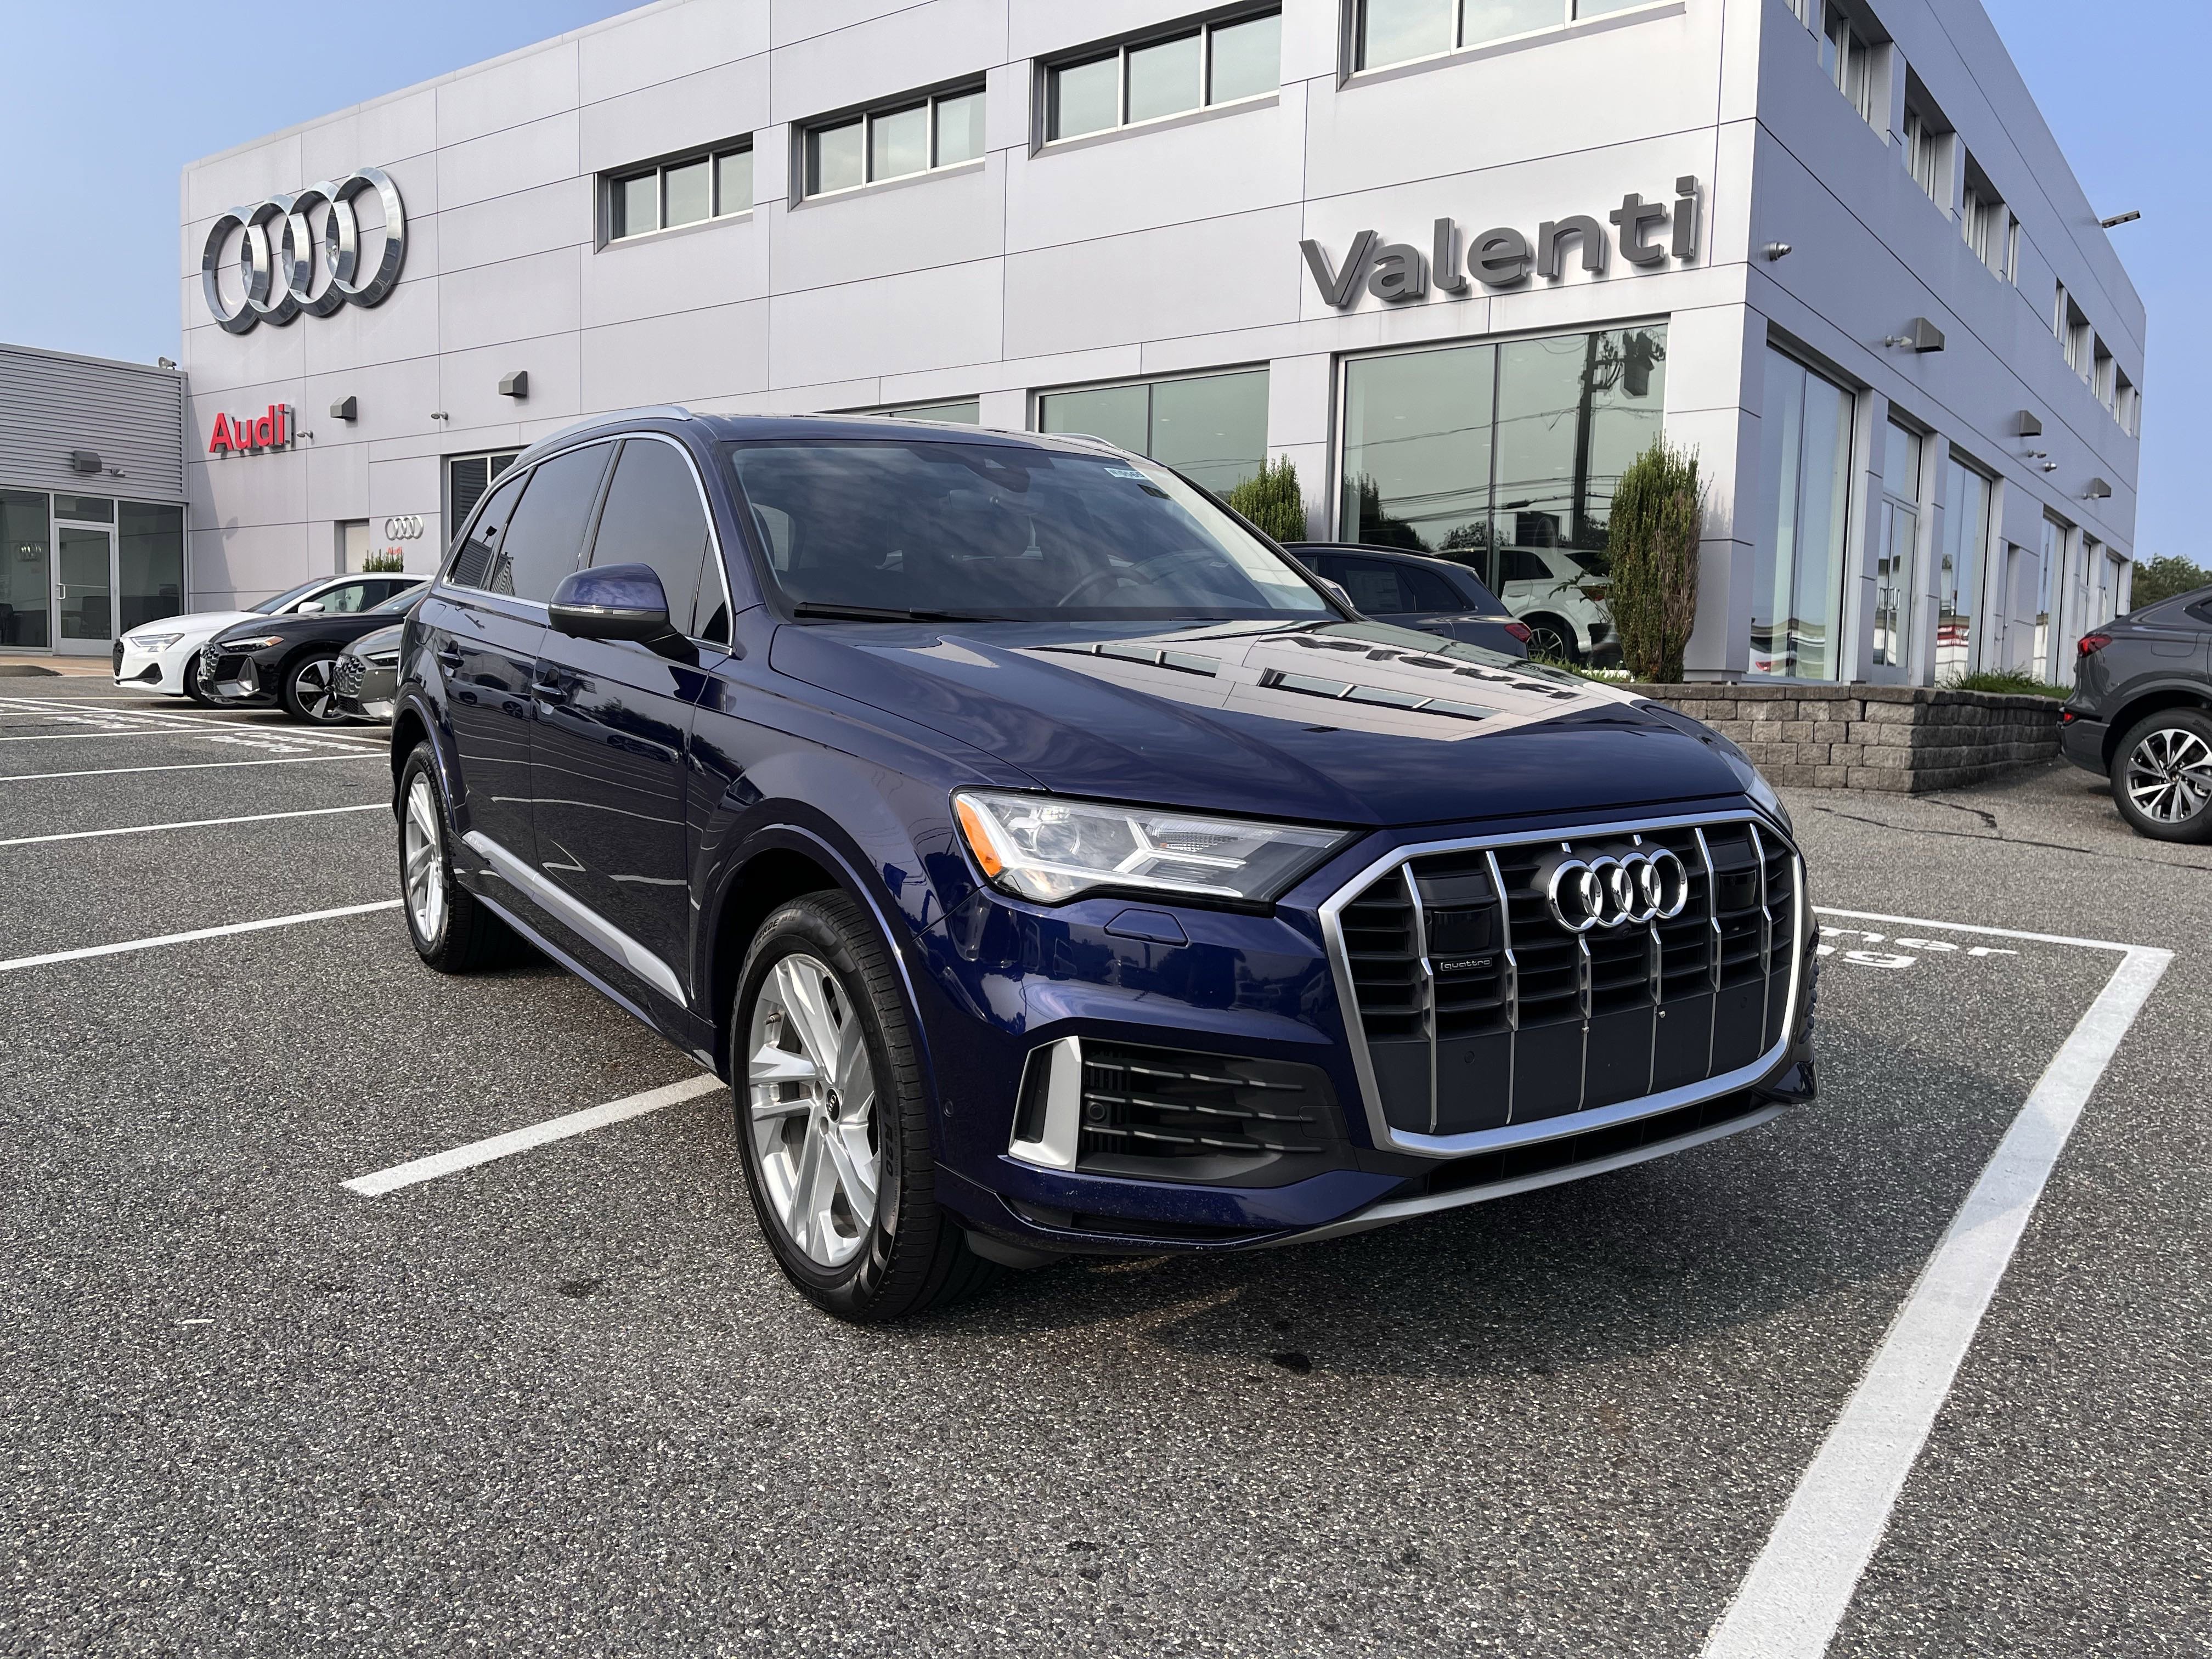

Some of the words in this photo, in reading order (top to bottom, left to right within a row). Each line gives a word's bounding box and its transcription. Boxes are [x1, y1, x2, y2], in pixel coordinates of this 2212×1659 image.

[1299, 176, 1699, 307] Valenti
[209, 404, 287, 453] Audi
[1444, 960, 1491, 969] quattro
[884, 1122, 894, 1177] R20
